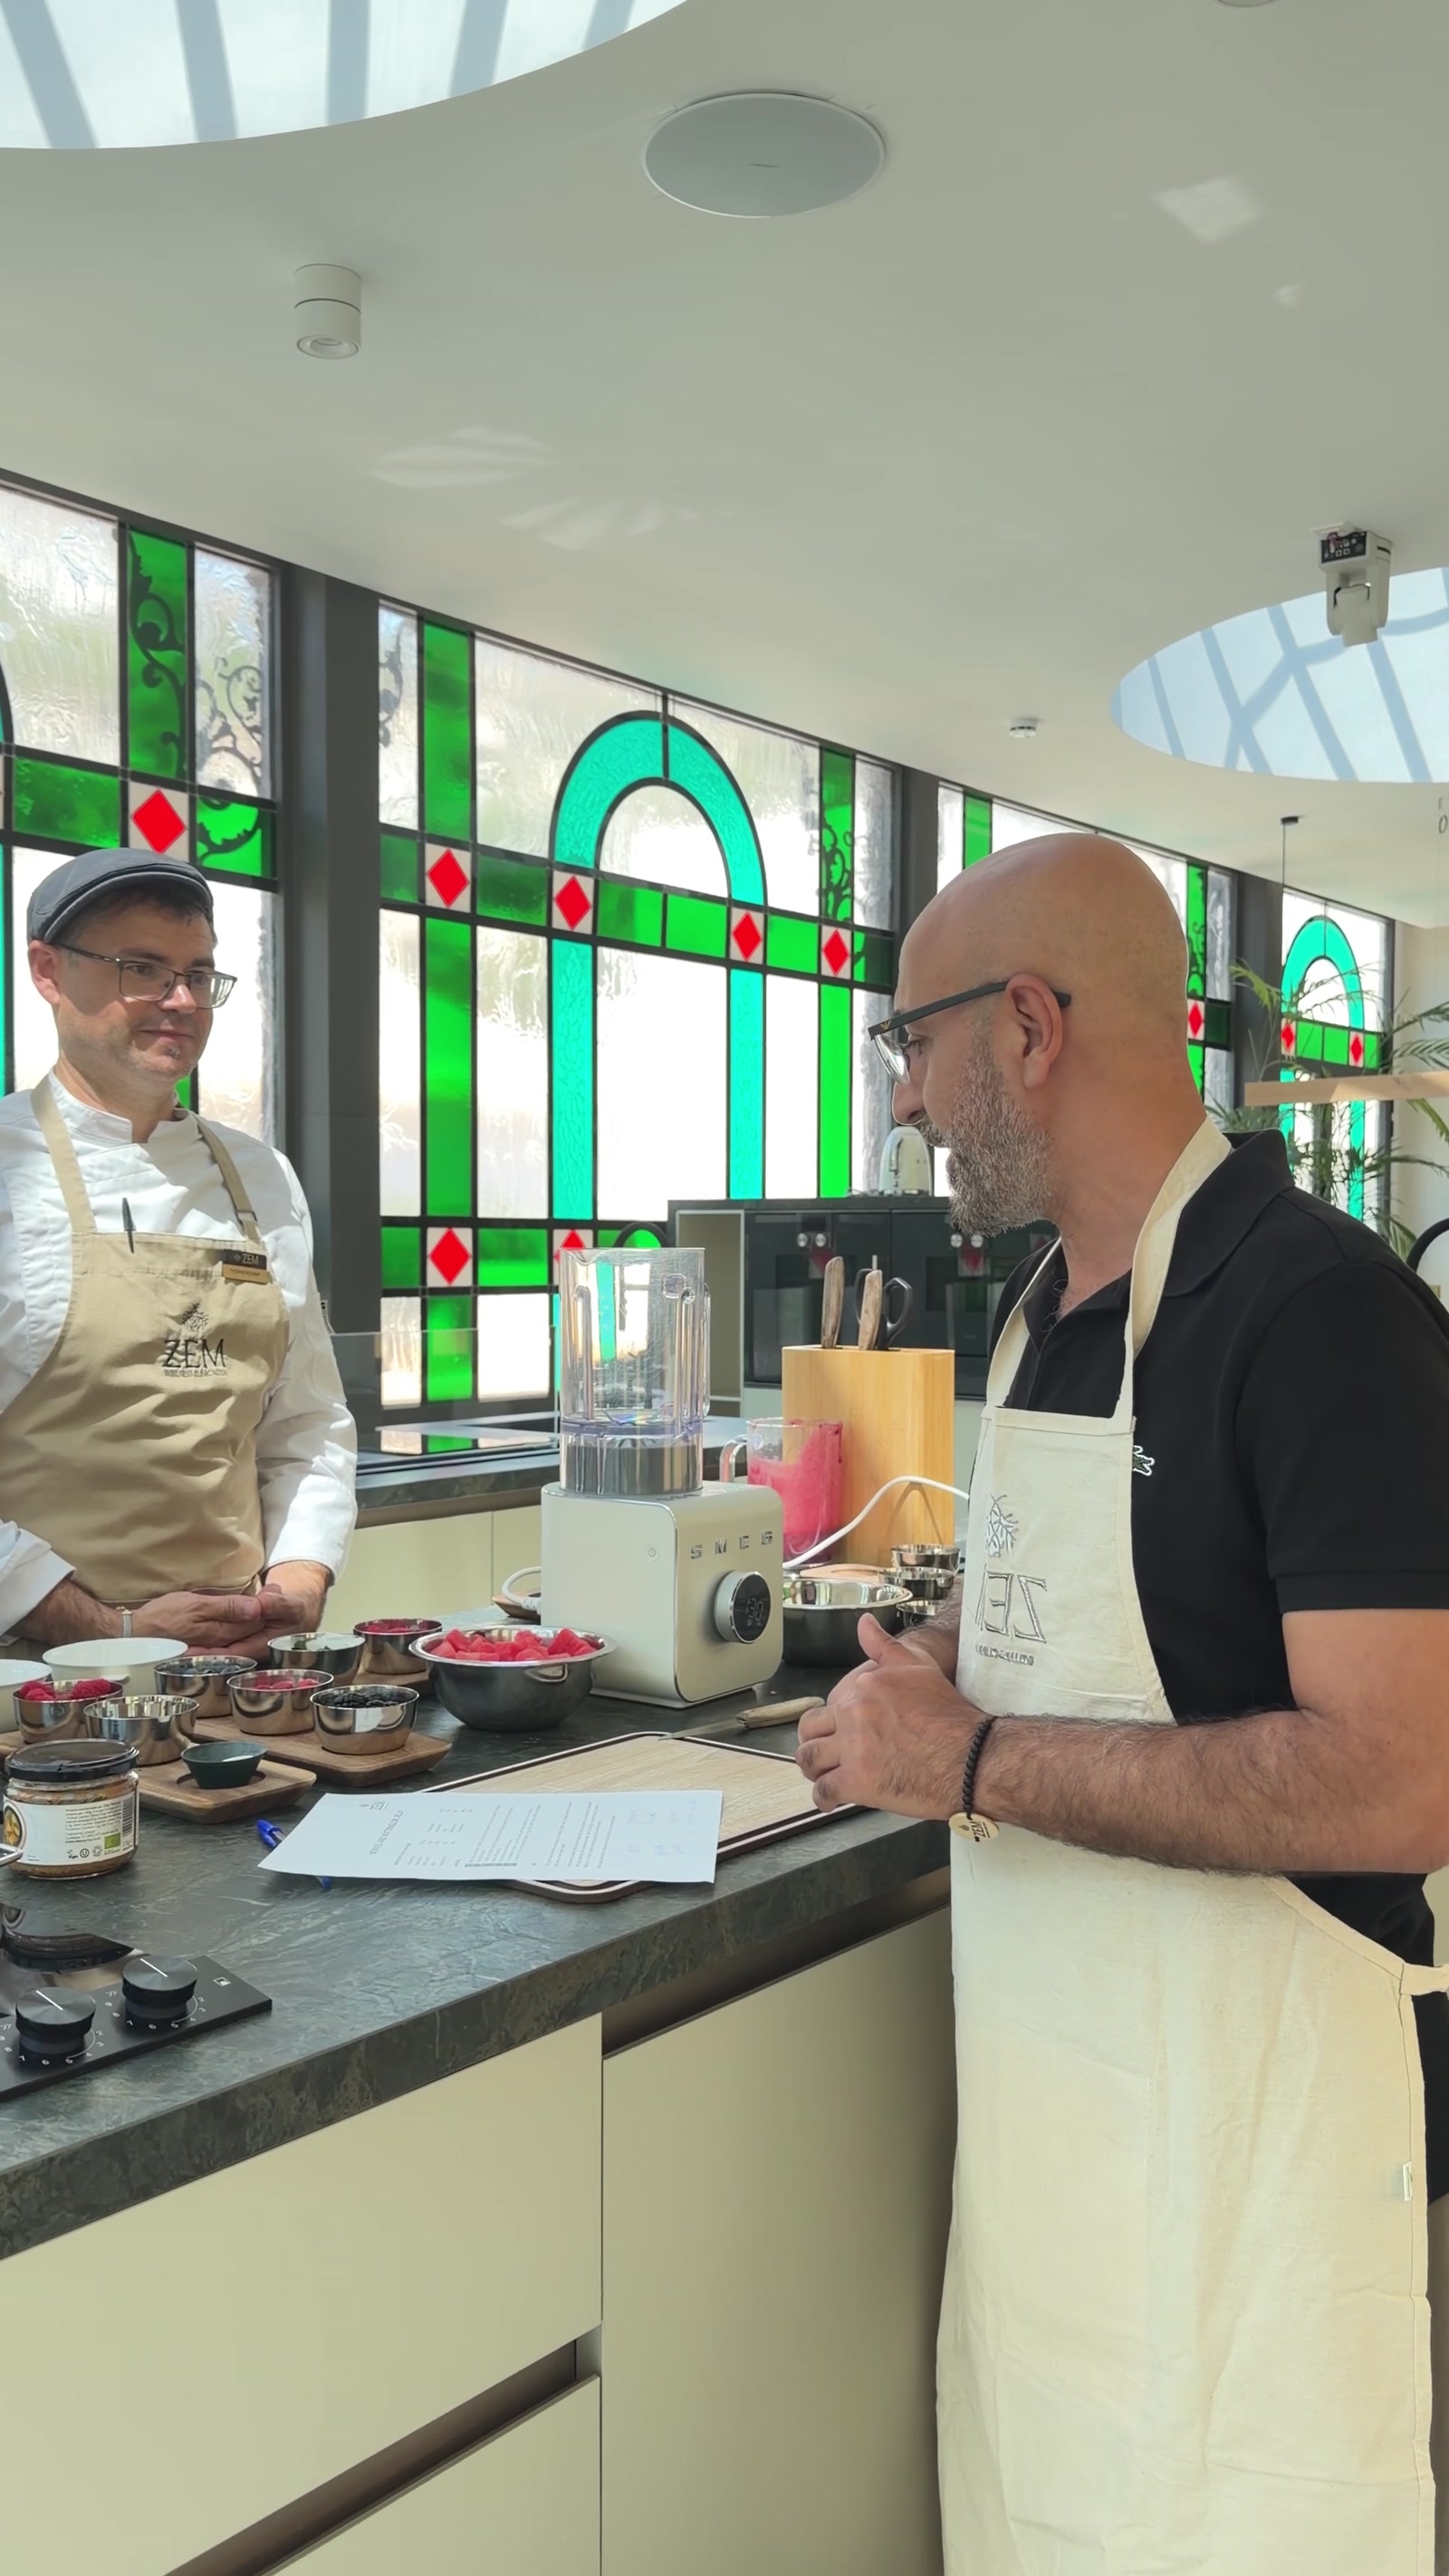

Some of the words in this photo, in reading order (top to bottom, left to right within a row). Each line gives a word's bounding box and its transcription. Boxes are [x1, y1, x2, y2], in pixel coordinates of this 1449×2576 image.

[242, 1253, 259, 1265] ZEM
[161, 1338, 226, 1369] ZEM
[691, 1531, 772, 1559] SMEG
[970, 1821, 986, 1838] ZEM
